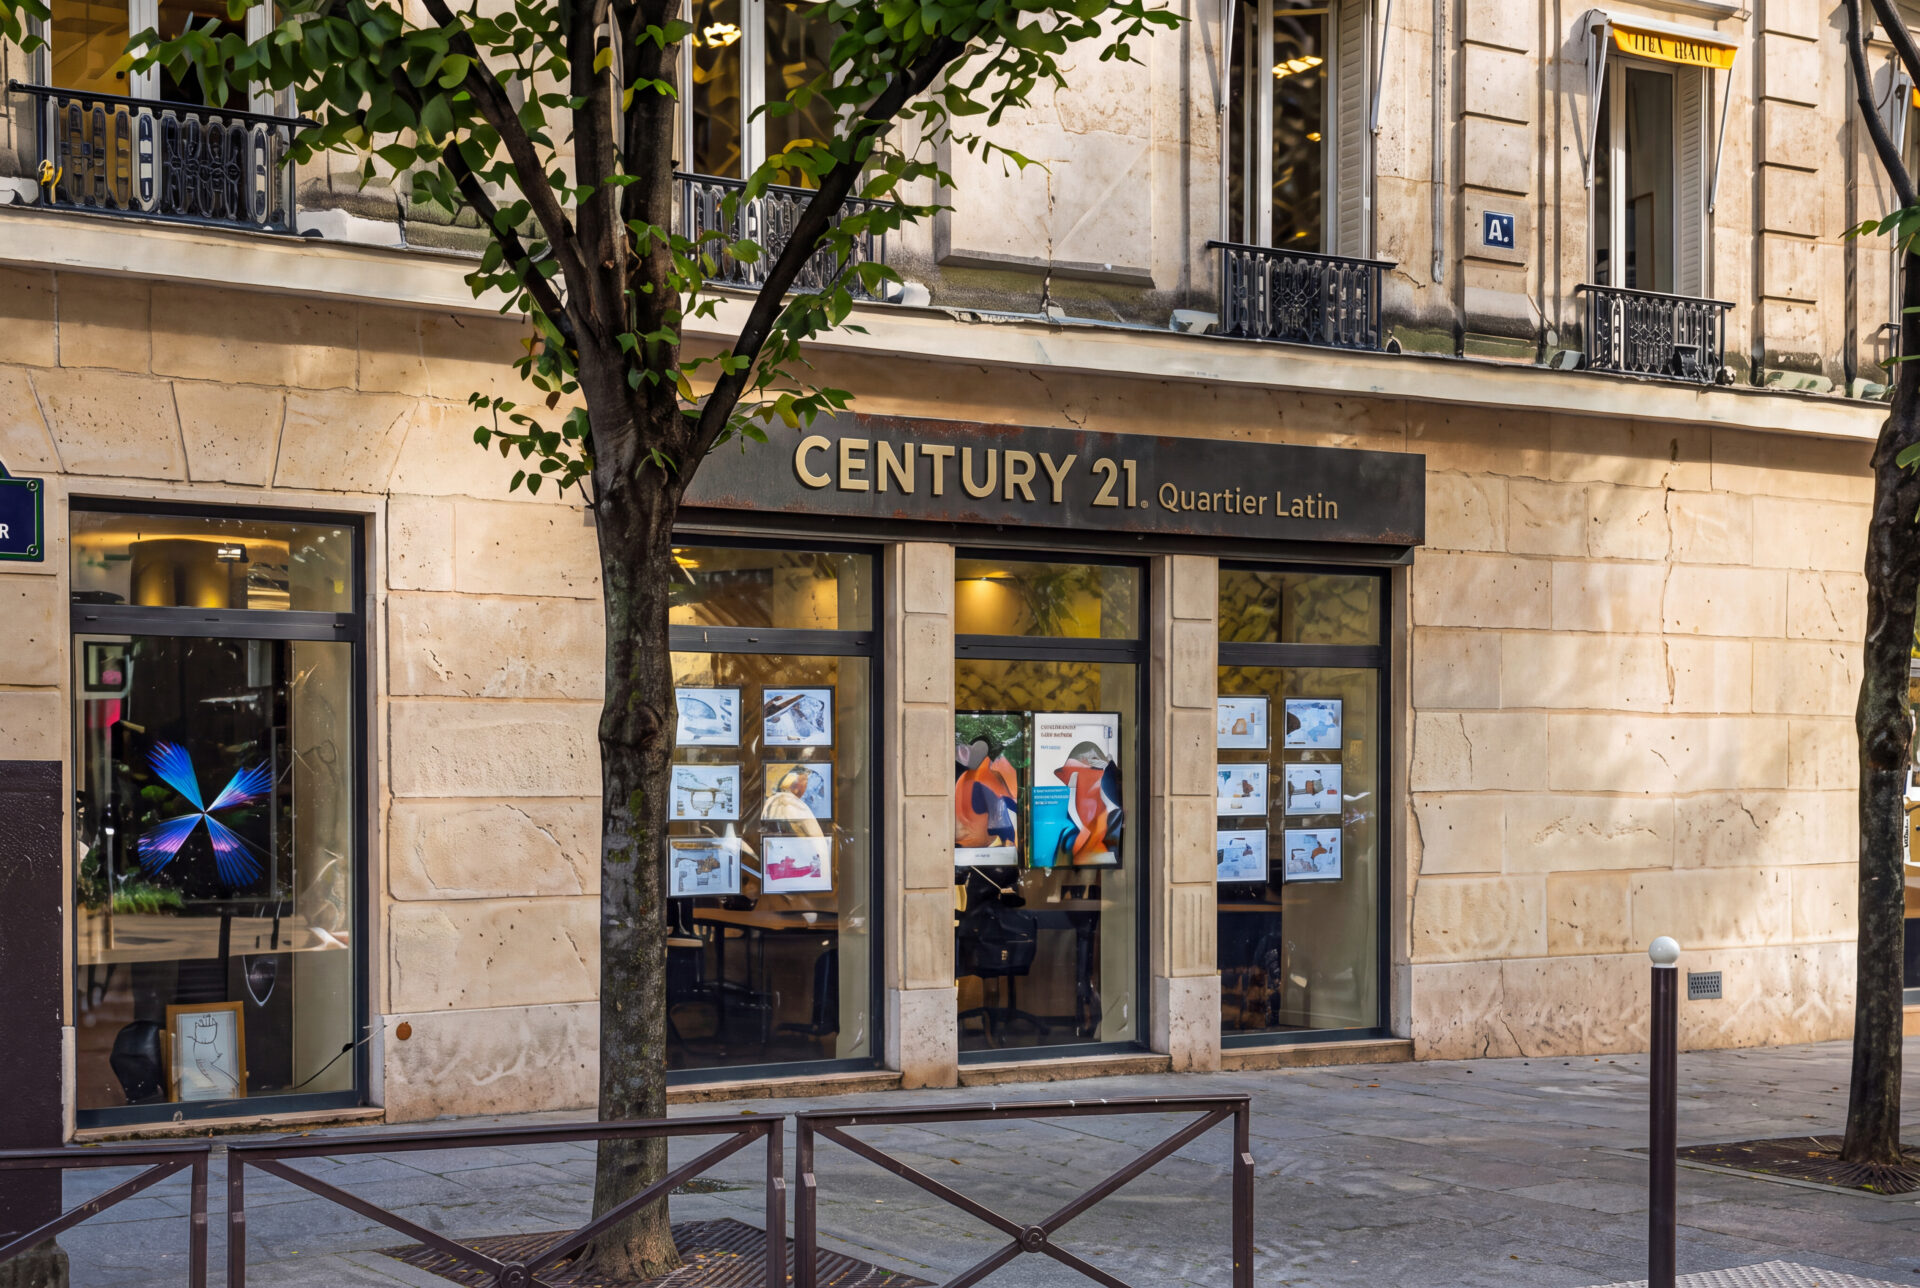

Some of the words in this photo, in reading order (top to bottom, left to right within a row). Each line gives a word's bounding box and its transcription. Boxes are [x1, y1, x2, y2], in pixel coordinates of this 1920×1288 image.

[795, 434, 1078, 503] CENTURY
[1158, 482, 1268, 515] Quartier
[1276, 491, 1338, 520] Latin
